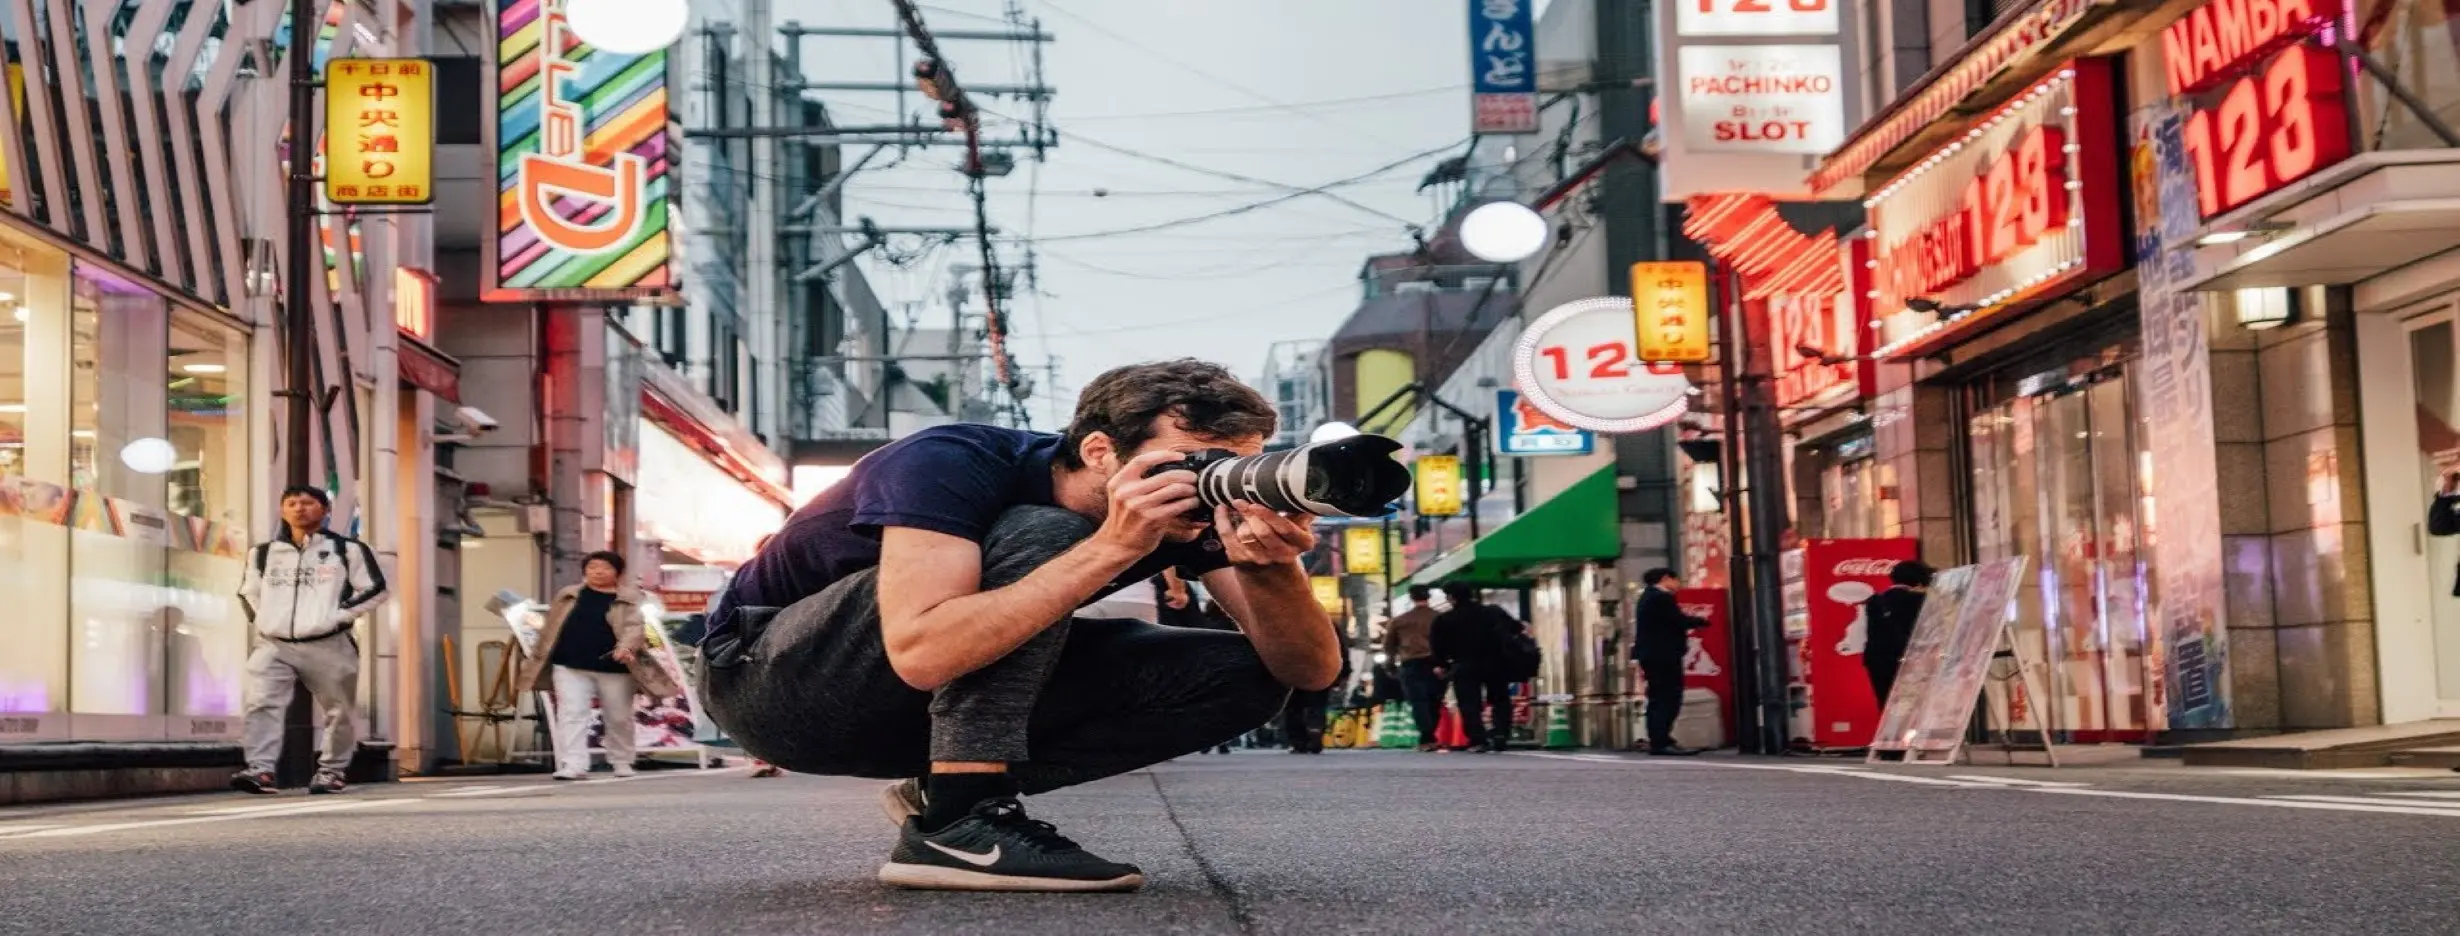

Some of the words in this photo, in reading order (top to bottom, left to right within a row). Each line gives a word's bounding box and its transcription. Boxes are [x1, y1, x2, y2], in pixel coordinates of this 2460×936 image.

[359, 82, 399, 178] 中央通り
[1690, 75, 1831, 94] PACHINKO
[1714, 120, 1811, 142] SLOT
[2186, 45, 2316, 217] 123
[522, 155, 641, 252] D
[1965, 126, 2049, 267] 123
[1832, 557, 1902, 577] Coca-Col
